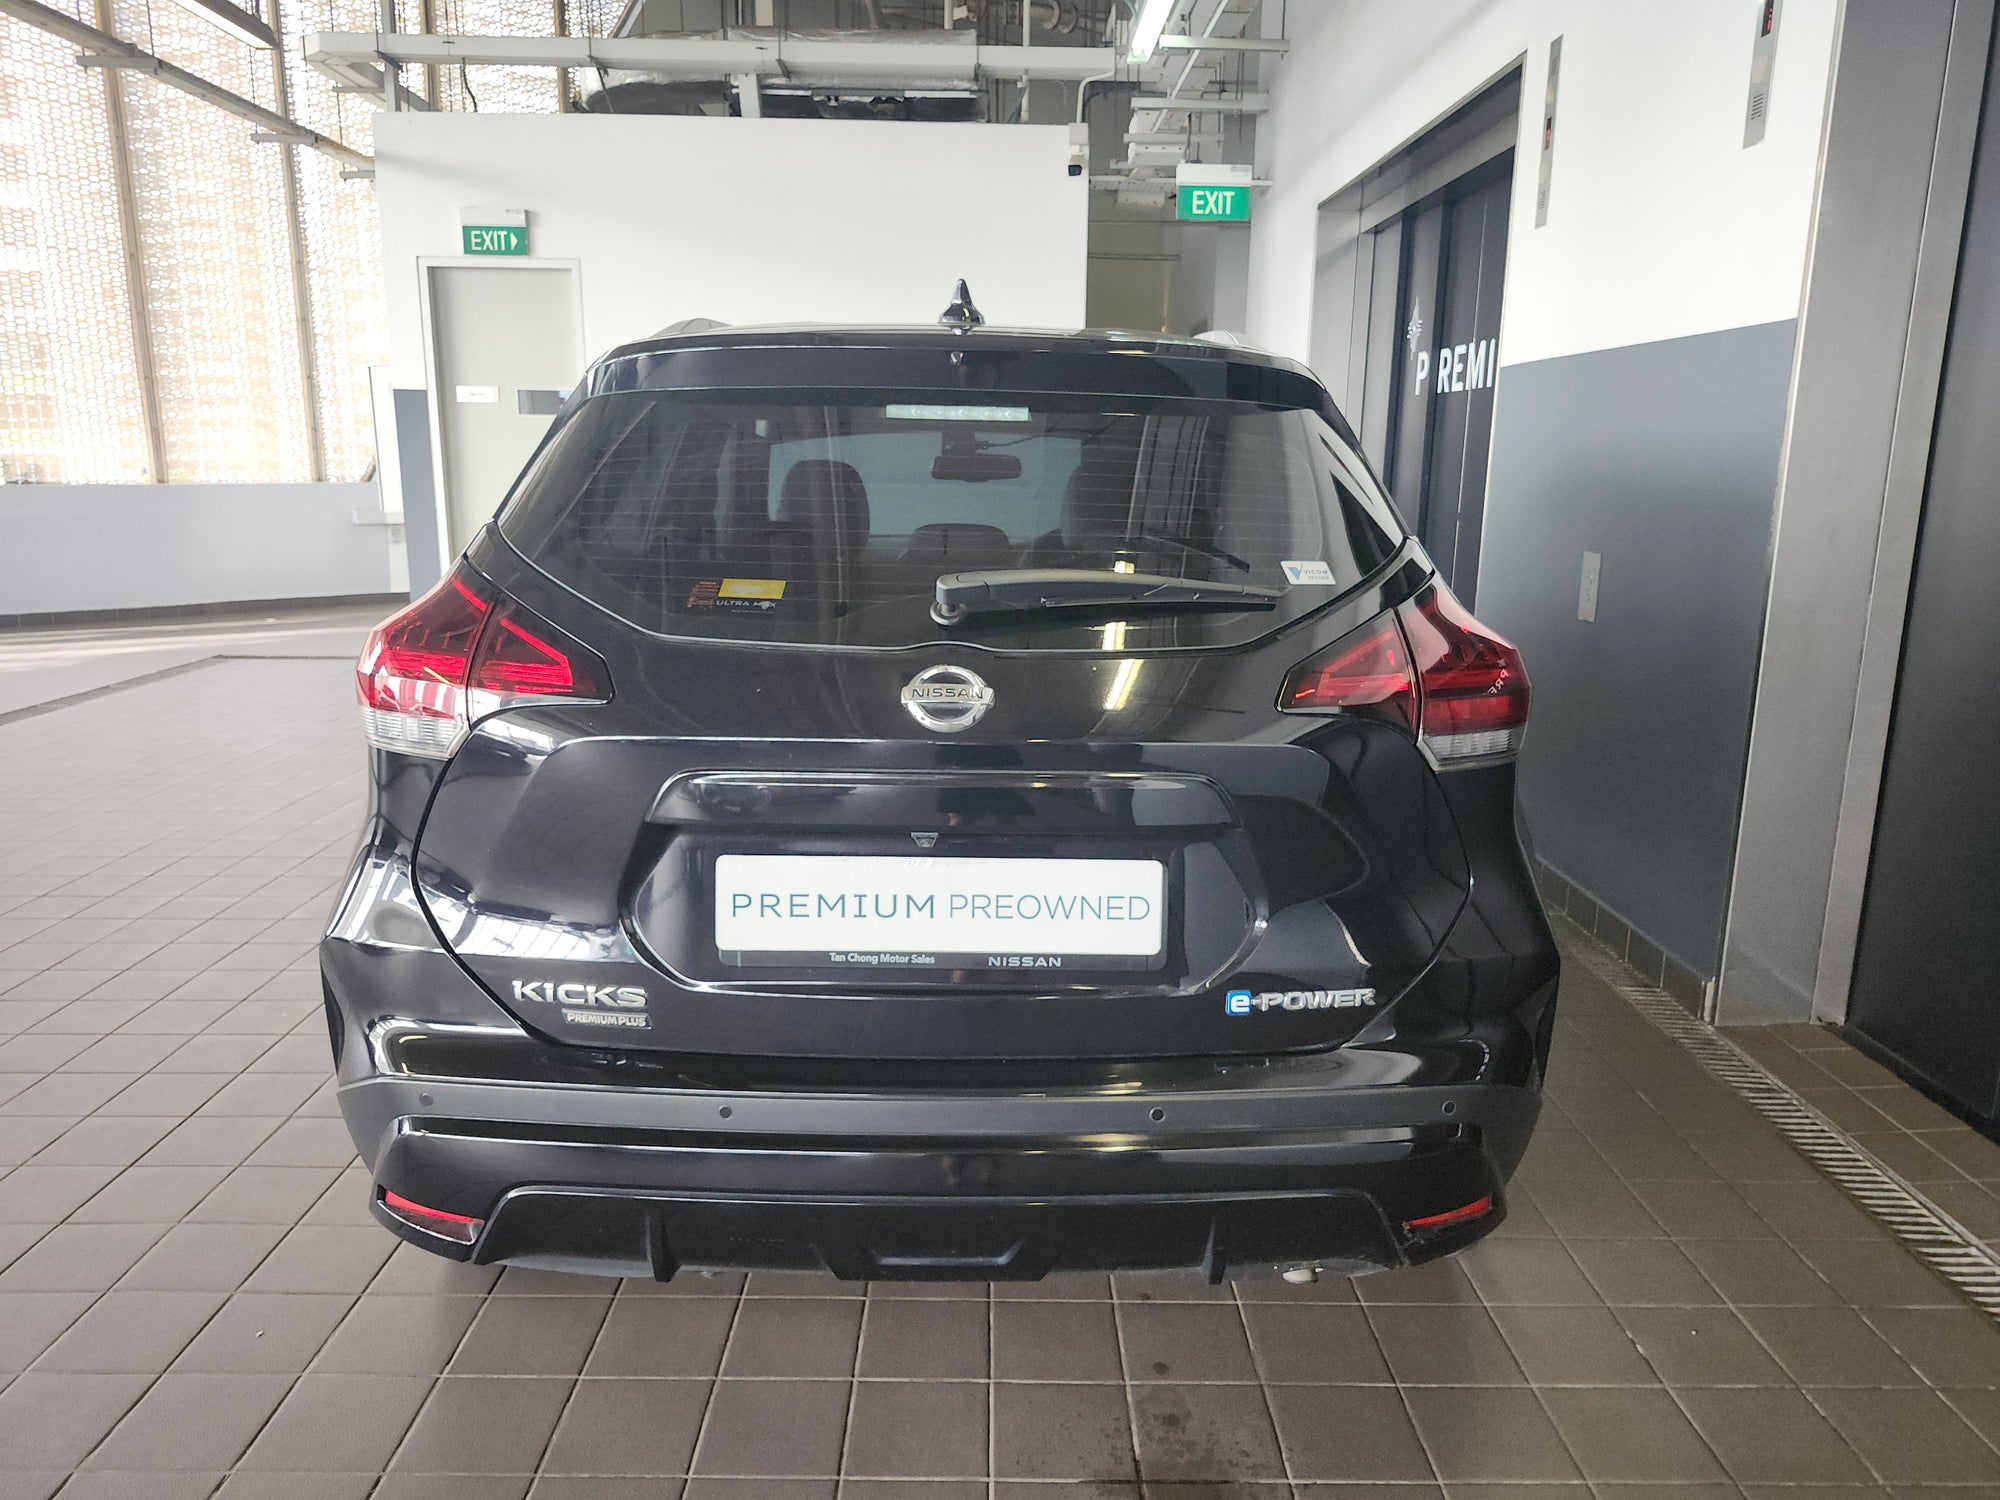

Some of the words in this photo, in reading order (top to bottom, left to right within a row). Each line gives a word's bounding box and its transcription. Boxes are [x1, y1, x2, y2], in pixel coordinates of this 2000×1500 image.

[1192, 190, 1235, 215] EXIT
[470, 230, 507, 251] EXIT
[753, 601, 776, 609] MX
[911, 687, 984, 699] NISSAN
[732, 893, 935, 919] PREMIUM
[949, 894, 1150, 920] PREOWNED
[829, 952, 846, 963] Tan
[847, 952, 879, 965] Chong
[880, 953, 910, 964] Motor
[911, 954, 936, 965] Sales
[988, 956, 1062, 967] NISSAN
[512, 979, 648, 1008] KICKS
